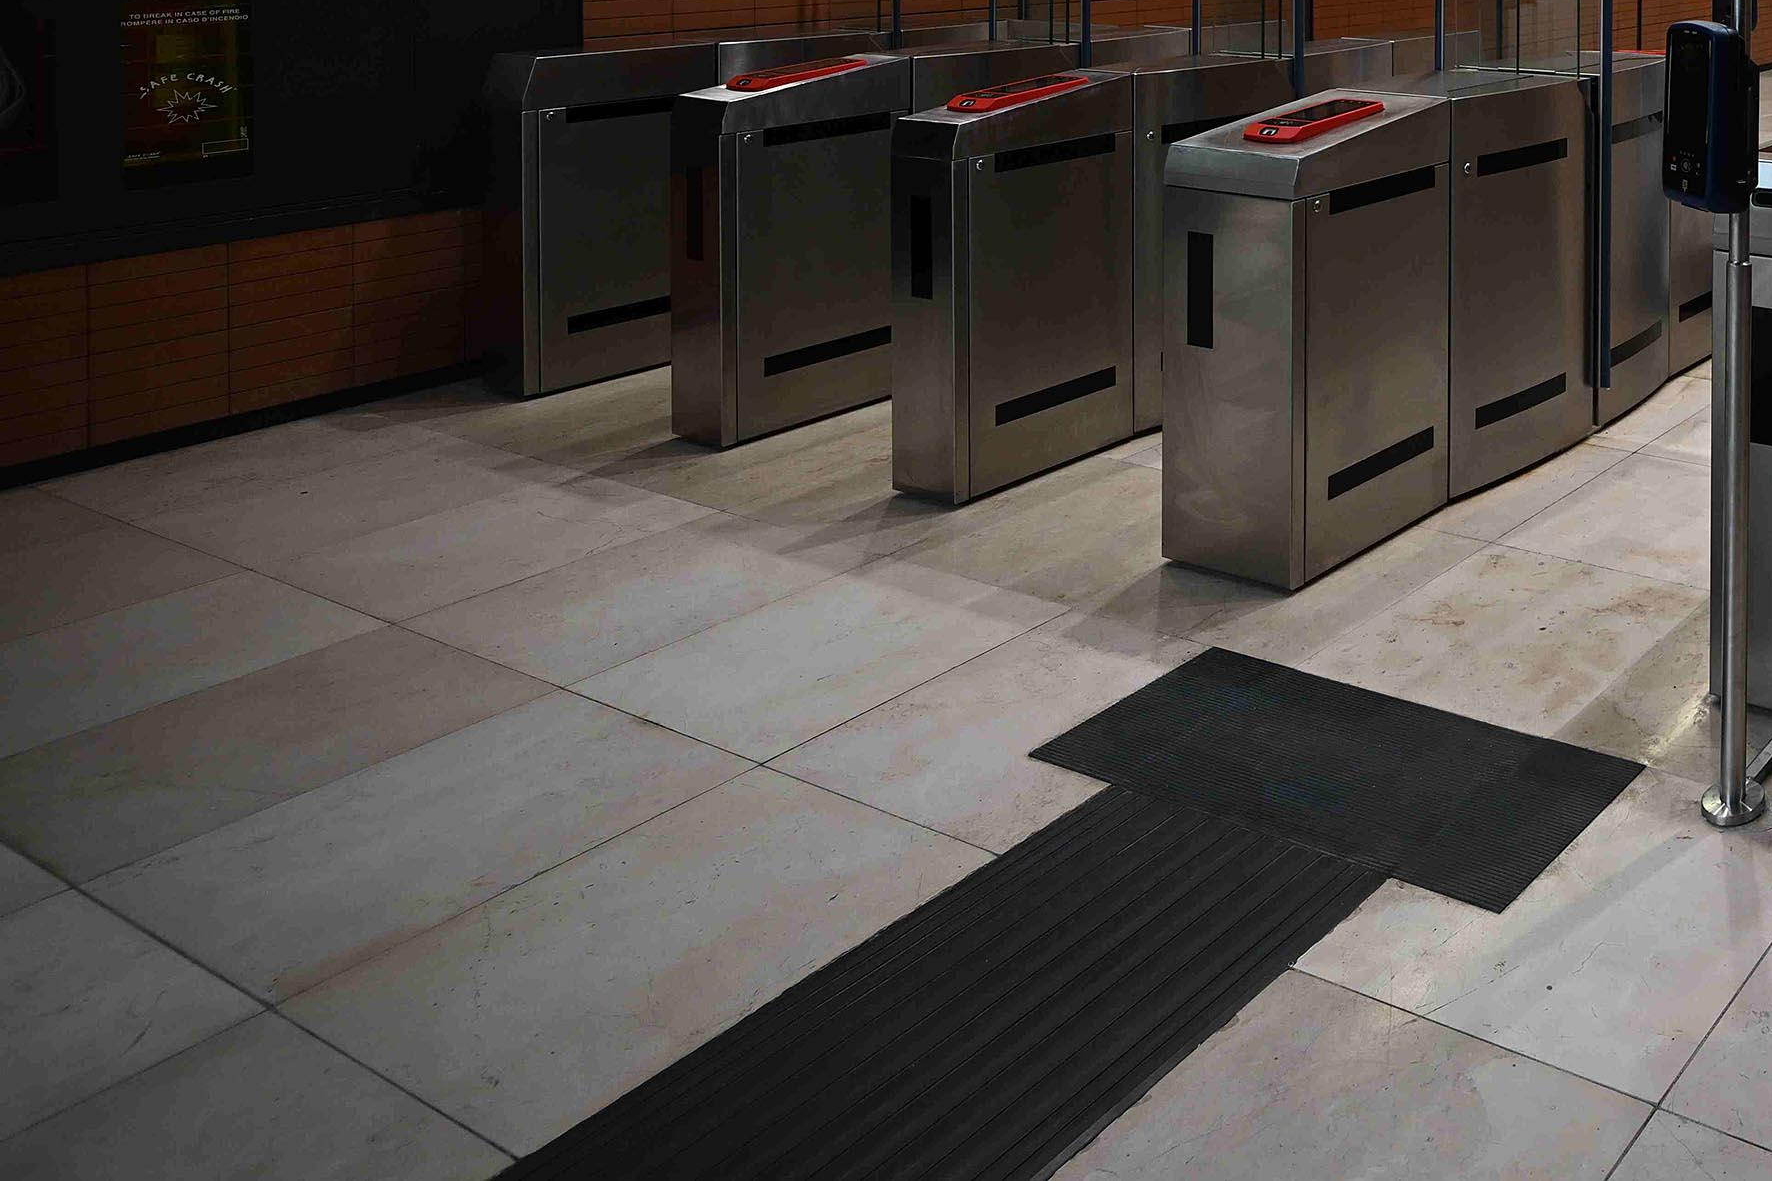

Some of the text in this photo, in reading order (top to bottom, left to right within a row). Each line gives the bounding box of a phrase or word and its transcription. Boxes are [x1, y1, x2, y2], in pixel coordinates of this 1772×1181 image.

[120, 19, 163, 28] ROMPERE
[175, 17, 199, 25] CASO
[202, 14, 249, 23] D'INCENDIO
[129, 13, 141, 21] TO
[143, 11, 173, 20] BREAK
[209, 8, 220, 16] OF
[222, 7, 241, 15] FIRE
[186, 72, 233, 94] CRASH
